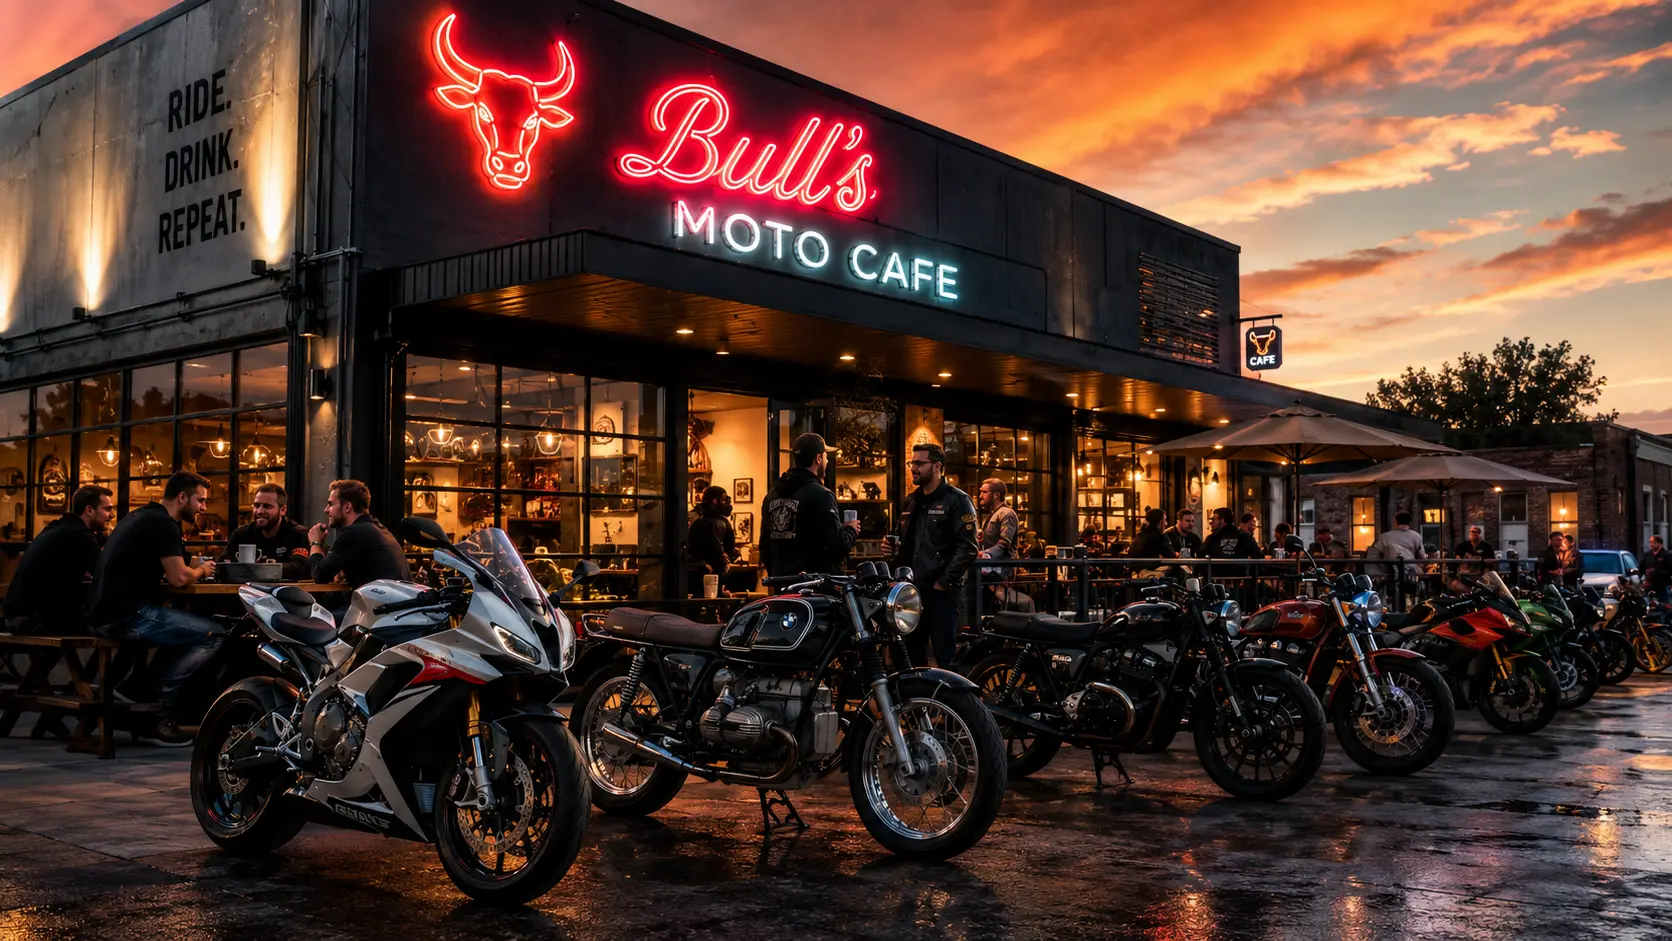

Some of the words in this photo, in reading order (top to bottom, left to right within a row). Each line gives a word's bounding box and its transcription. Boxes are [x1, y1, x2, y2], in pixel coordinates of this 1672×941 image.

[168, 68, 232, 134] RIDE.
[164, 128, 239, 193] DRINK.
[620, 83, 873, 212] Bull's
[158, 188, 245, 254] REPEAT.
[673, 200, 830, 269] MOTO
[849, 243, 958, 300] CAFE
[1249, 354, 1276, 366] CAFE
